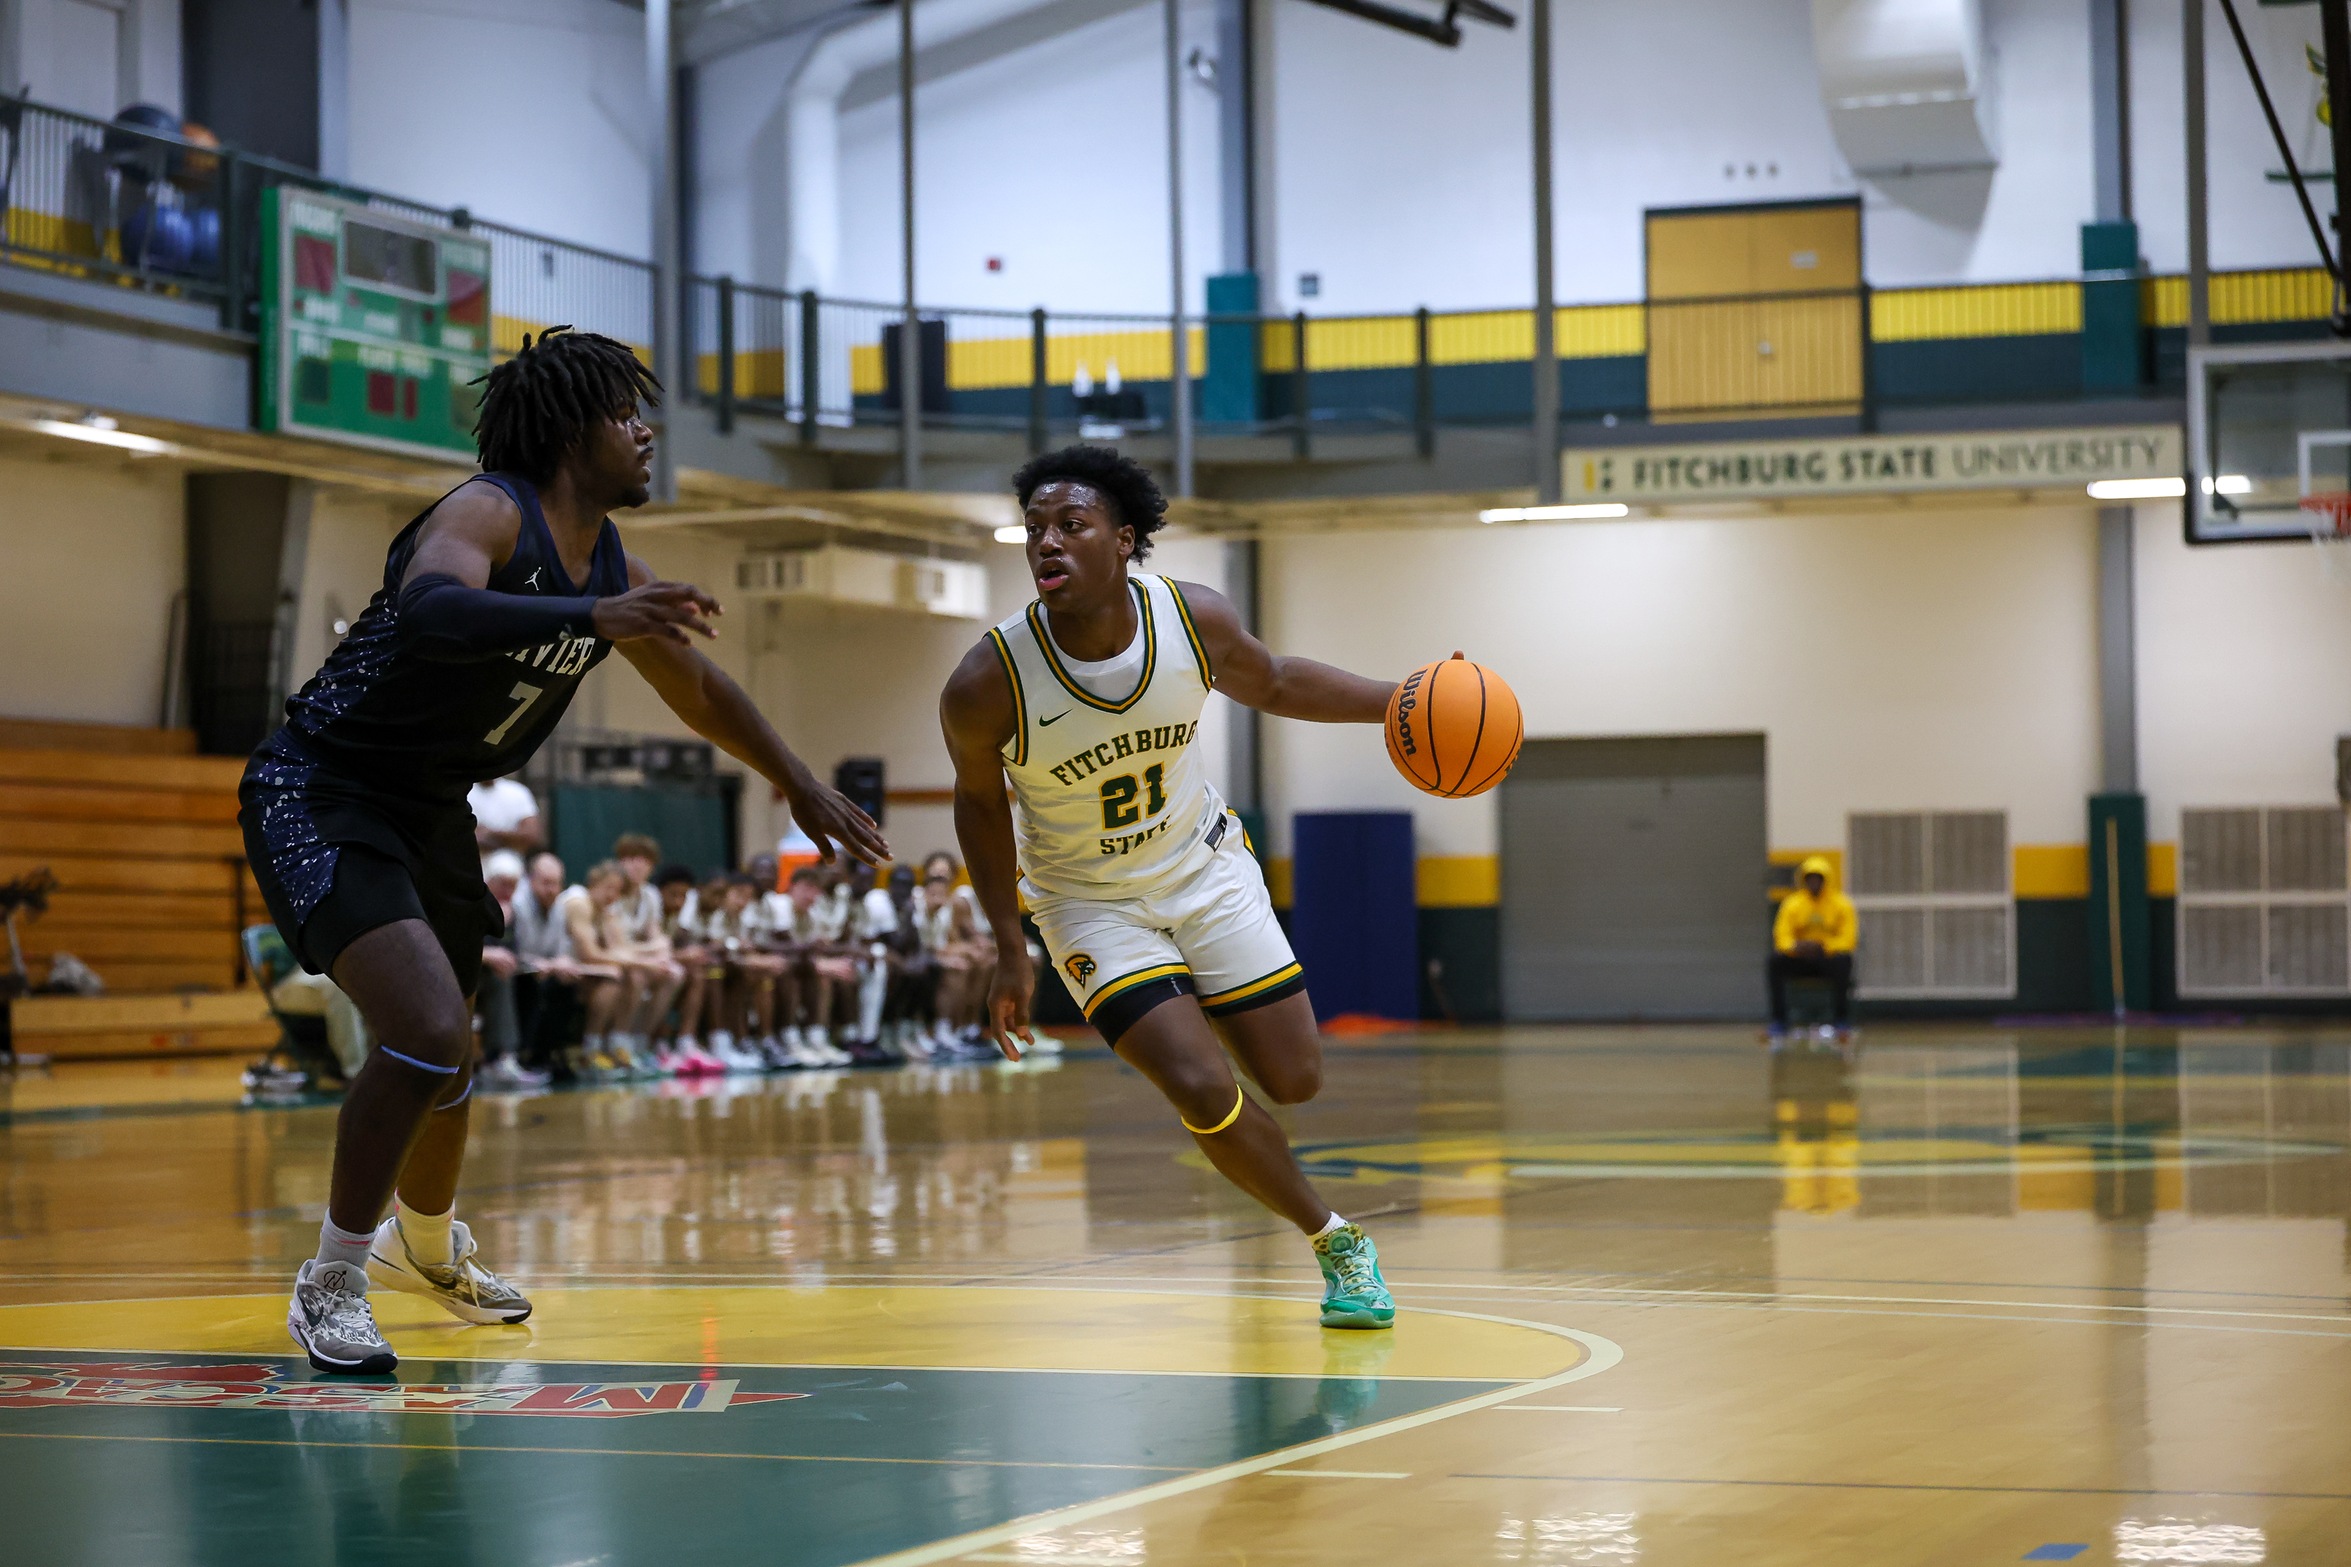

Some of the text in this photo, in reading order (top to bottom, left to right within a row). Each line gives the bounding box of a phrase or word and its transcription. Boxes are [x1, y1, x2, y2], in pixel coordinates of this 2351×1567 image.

[1634, 435, 2165, 489] FITCHBURG STATE UNIVERSITY
[505, 637, 596, 675] VIER
[483, 681, 543, 745] 7
[1398, 668, 1428, 757] Wilson
[1049, 720, 1198, 786] FITCHBURG
[1099, 761, 1168, 831] 21
